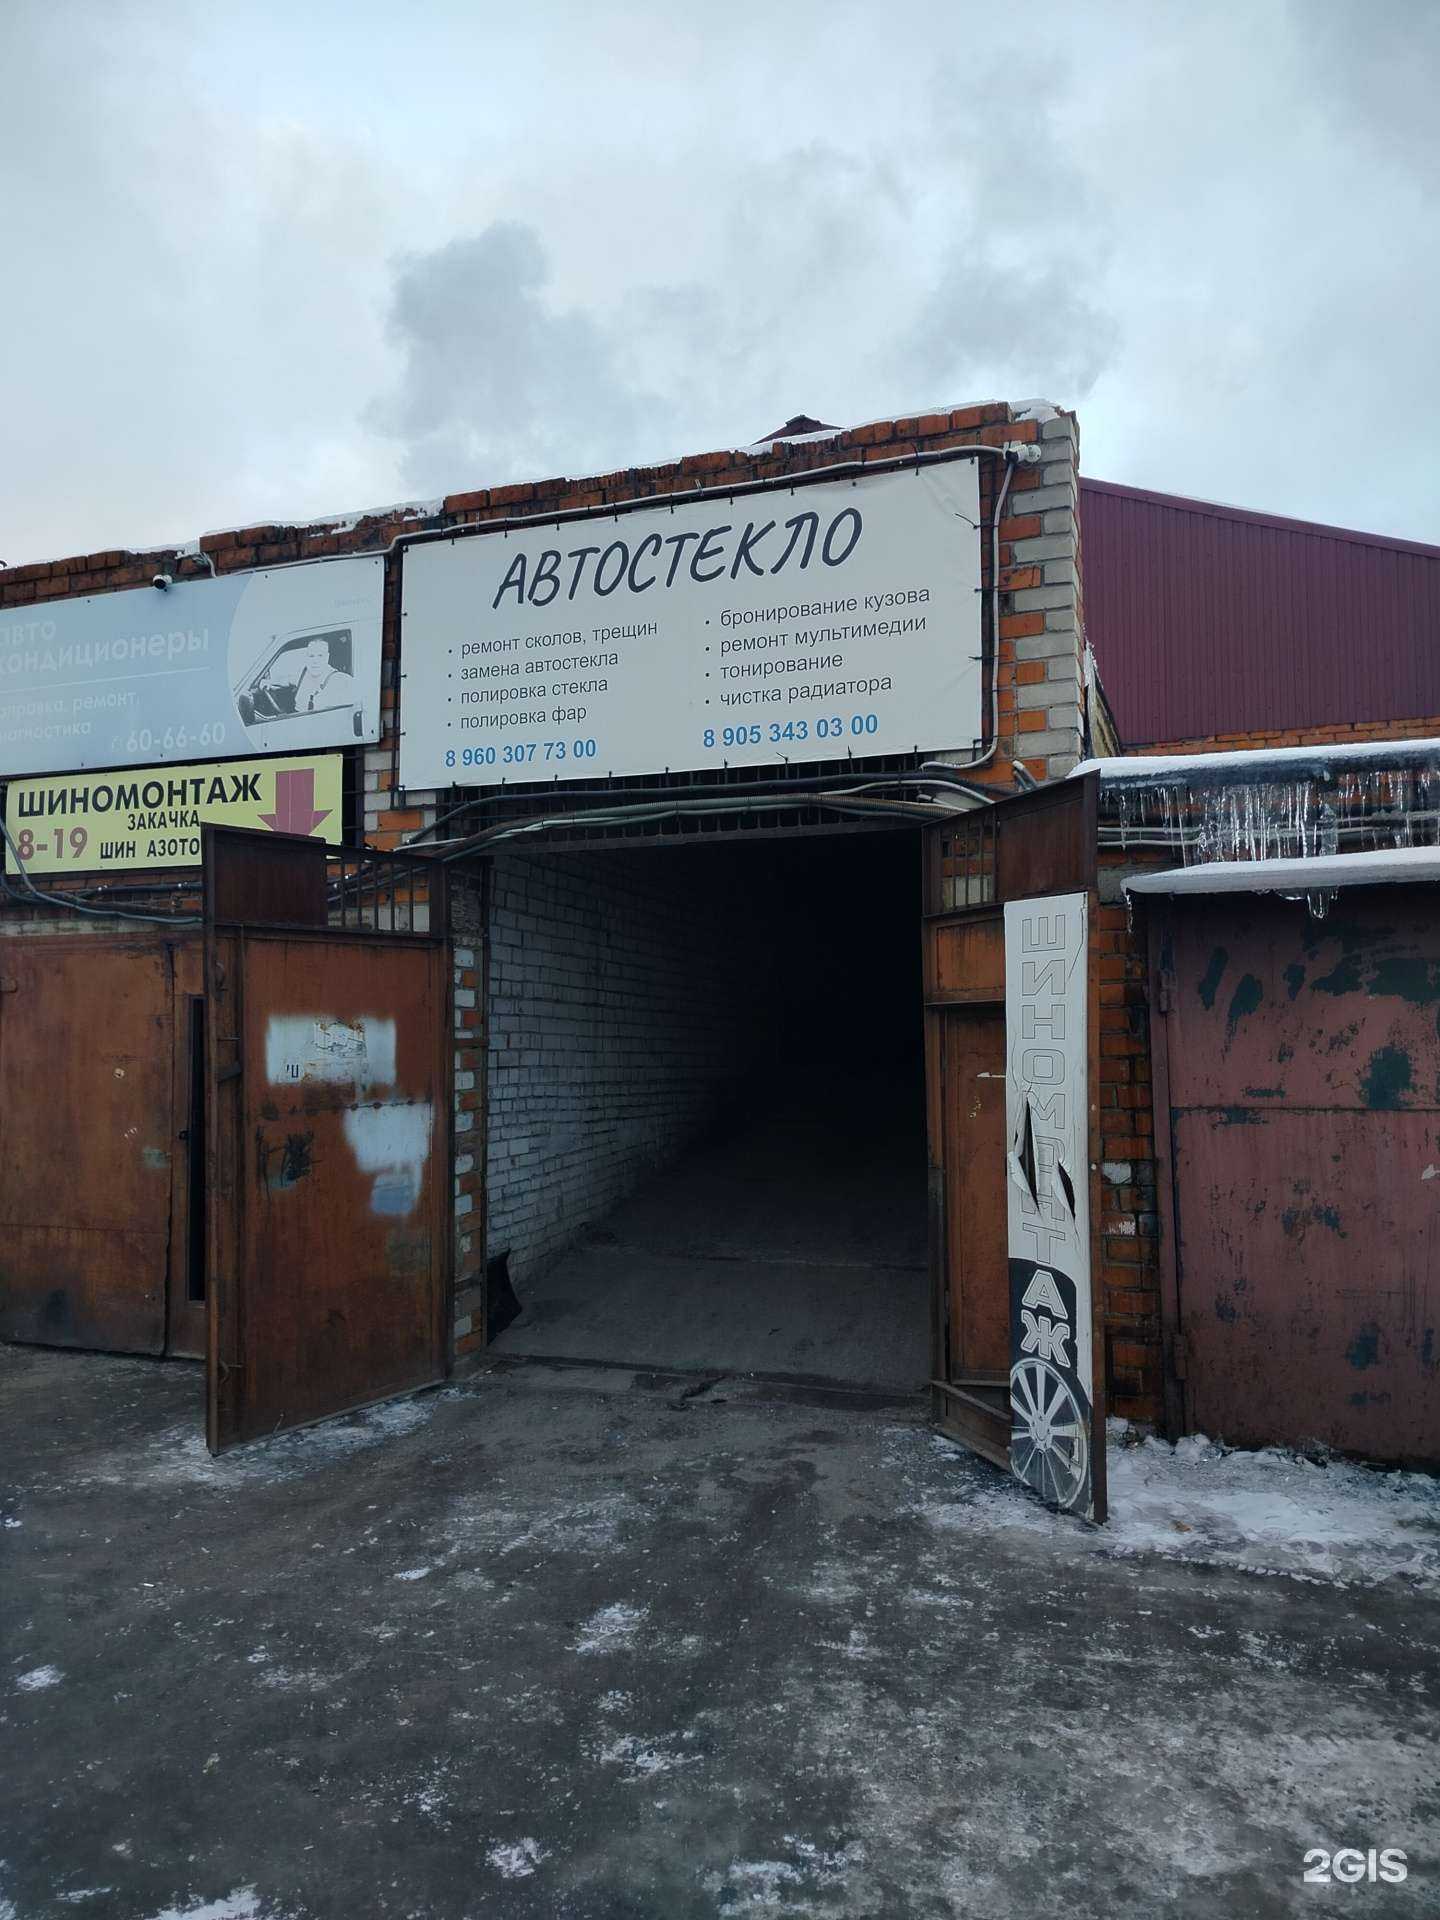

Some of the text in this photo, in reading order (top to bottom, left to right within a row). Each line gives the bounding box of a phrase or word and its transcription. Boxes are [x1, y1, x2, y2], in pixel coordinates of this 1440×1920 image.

[492, 507, 863, 610] АВТОСТЕКЛО
[720, 588, 930, 629] бронирование кузова
[461, 621, 658, 659] ремонт сколов, трещин
[720, 616, 928, 657] ремонт мультимедии
[461, 651, 619, 681] замена автостекла
[720, 653, 844, 679] тонирование
[461, 678, 608, 704] полировка стекла
[720, 675, 893, 707] чистка радиатора
[461, 705, 587, 730] полировка фар
[703, 714, 879, 748] 8 905 343 03 00
[127, 722, 225, 752] 60-66-60
[445, 739, 597, 767] 8 960 307 73 00
[18, 773, 262, 818] ШИНОМОНТАЖ
[127, 809, 200, 831] ЗАКАЧКА
[18, 826, 88, 861] 8-19
[99, 840, 137, 860] ШИН
